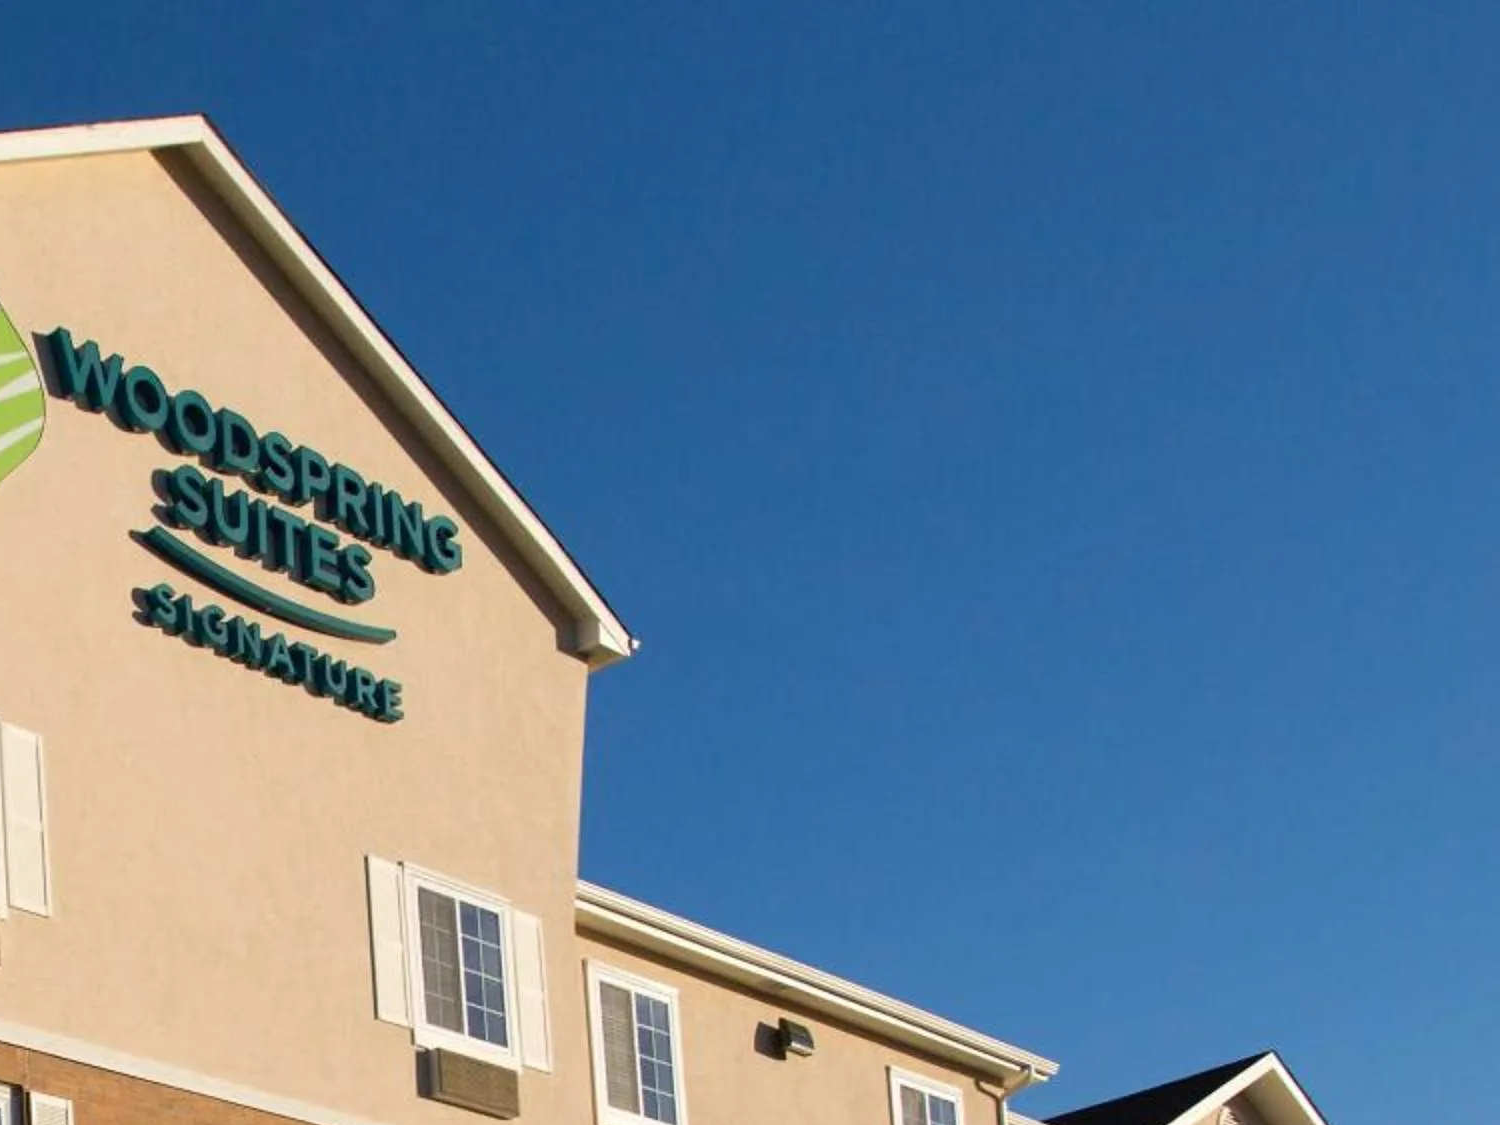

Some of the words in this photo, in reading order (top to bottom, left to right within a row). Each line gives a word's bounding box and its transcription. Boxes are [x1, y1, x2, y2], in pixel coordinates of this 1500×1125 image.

[43, 326, 462, 575] WOODSPRING
[160, 465, 375, 604] SUITES
[142, 583, 404, 722] SIGNATURE
